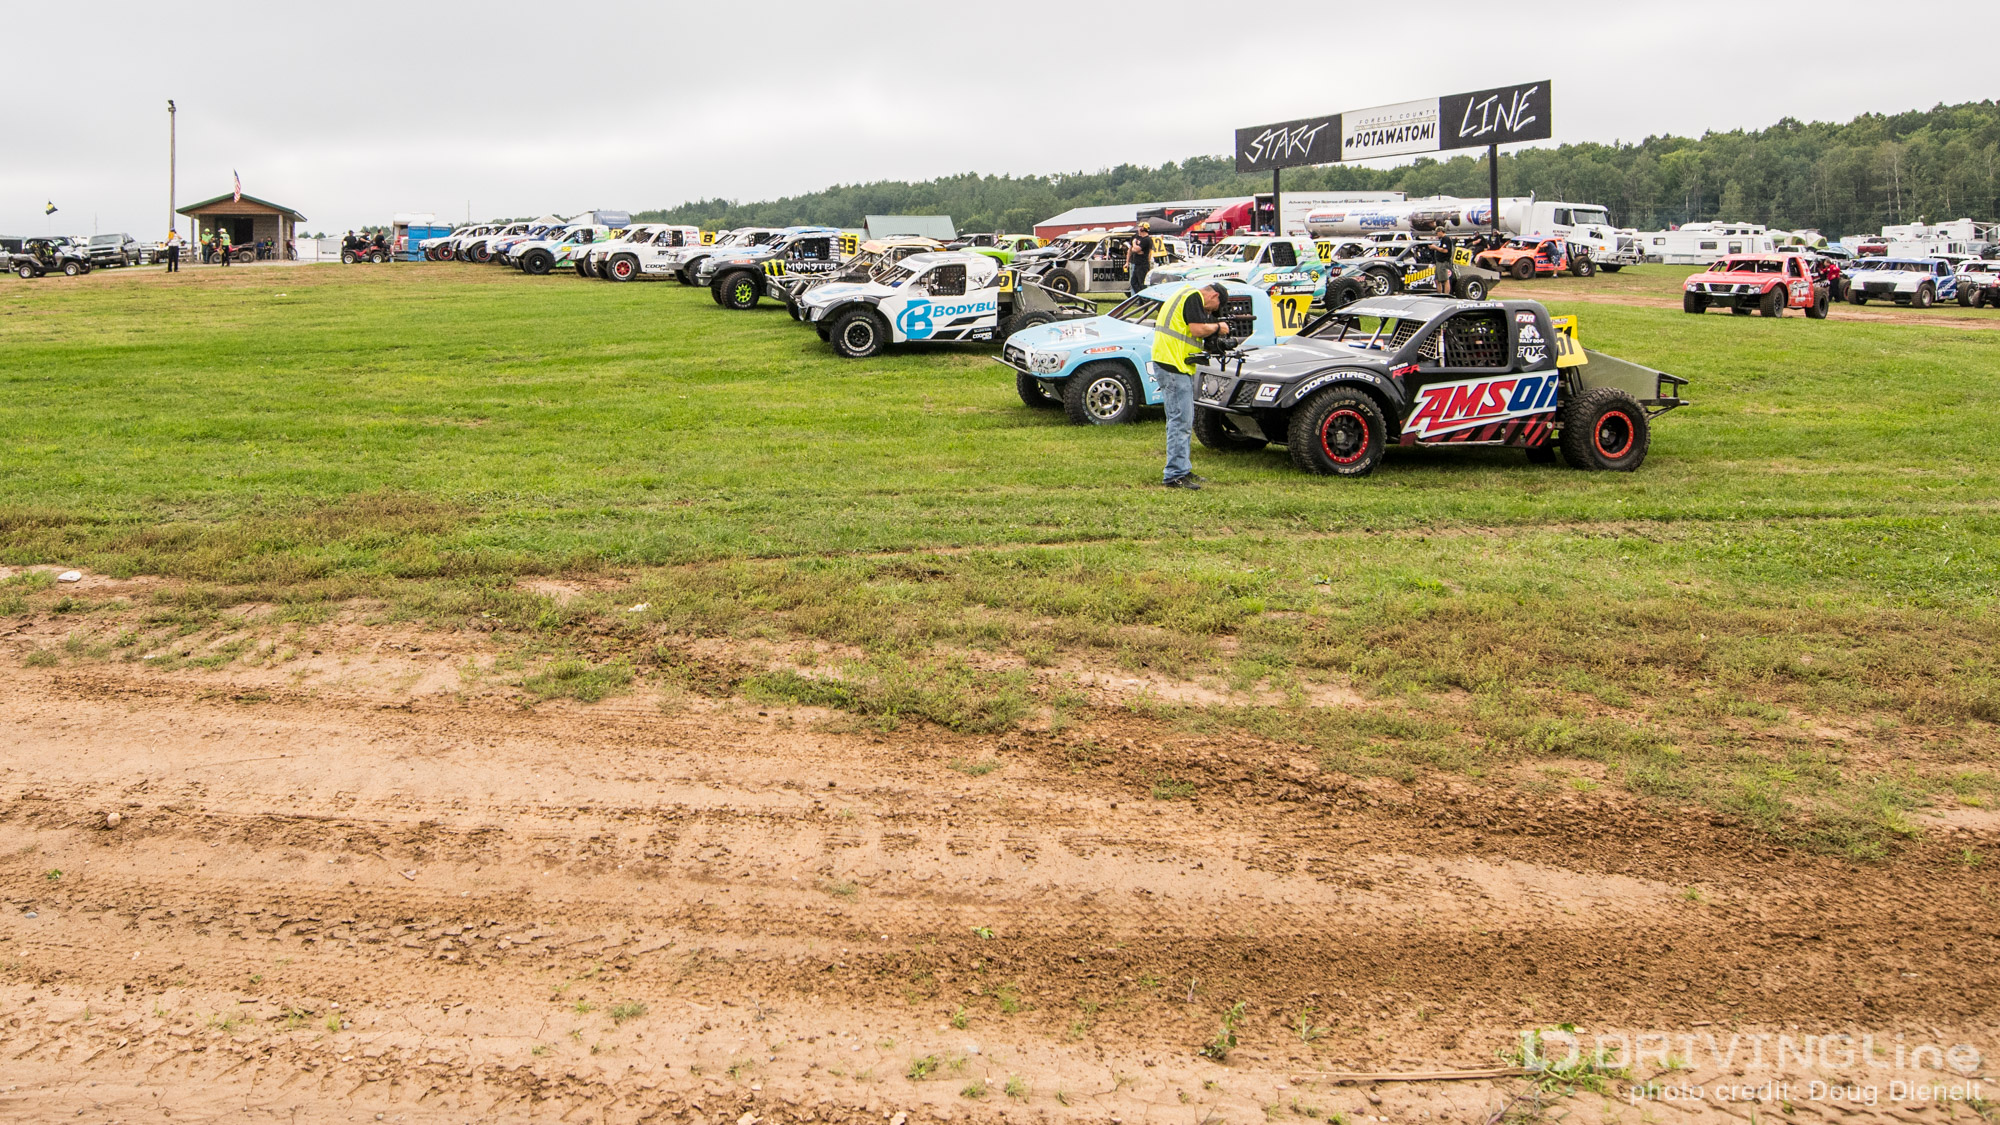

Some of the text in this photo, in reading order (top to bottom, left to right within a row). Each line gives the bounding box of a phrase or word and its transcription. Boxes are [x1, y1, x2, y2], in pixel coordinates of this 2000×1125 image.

[1358, 109, 1437, 125] FOREST COUNTY
[1458, 85, 1539, 138] LINE
[1355, 122, 1436, 148] POTAWATOMI
[1244, 122, 1329, 164] START
[703, 234, 714, 243] 8
[1190, 244, 1202, 256] 41
[1317, 244, 1330, 259] 22
[1455, 250, 1470, 263] 84
[785, 261, 837, 271] MONSTER
[1515, 314, 1535, 323] FXR
[1555, 325, 1575, 356] 51
[1516, 345, 1546, 359] FOX
[1392, 364, 1421, 379] RZR
